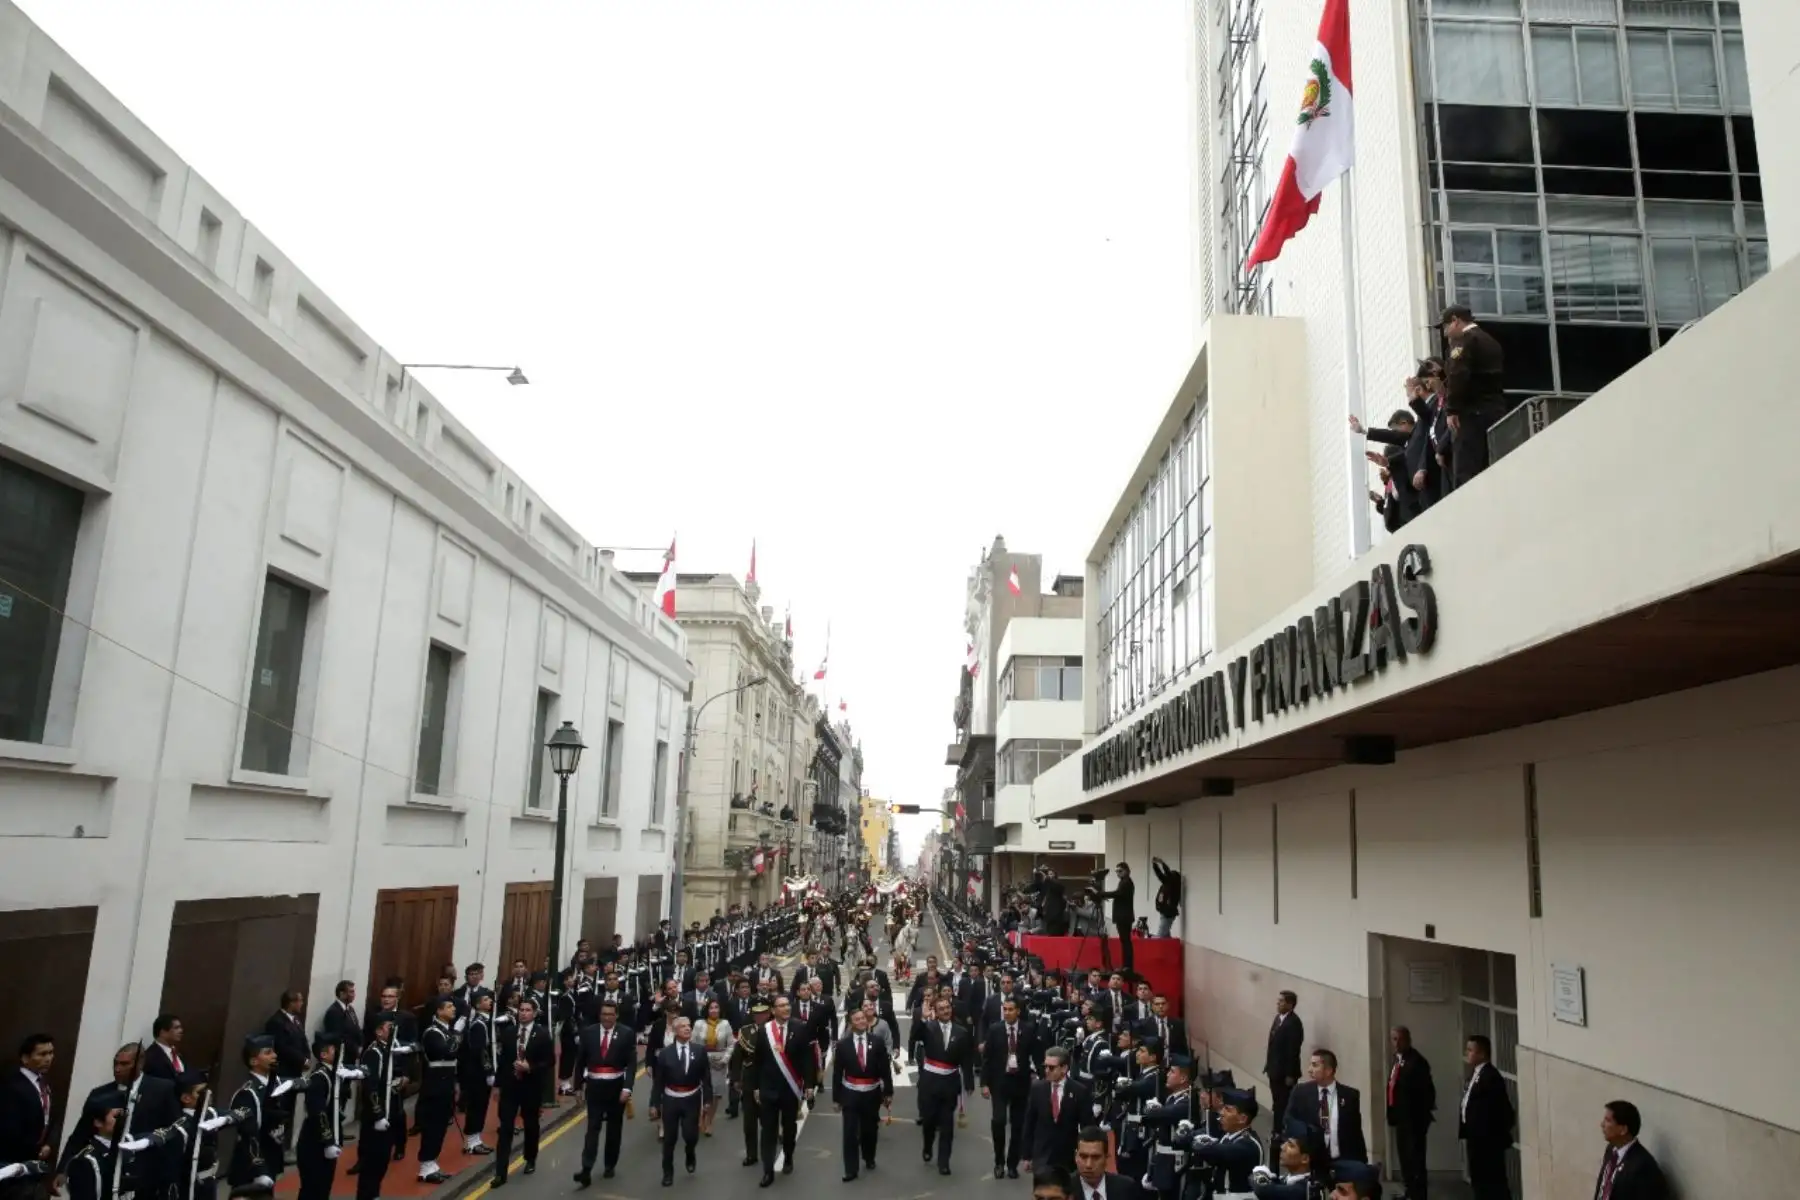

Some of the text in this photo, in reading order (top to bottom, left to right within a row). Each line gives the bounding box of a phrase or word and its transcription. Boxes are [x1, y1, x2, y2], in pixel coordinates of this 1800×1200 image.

[1128, 720, 1144, 773] DE
[1144, 670, 1230, 767] ECONOMIA
[1228, 655, 1247, 729] Y
[1250, 543, 1437, 723] FINANZAS
